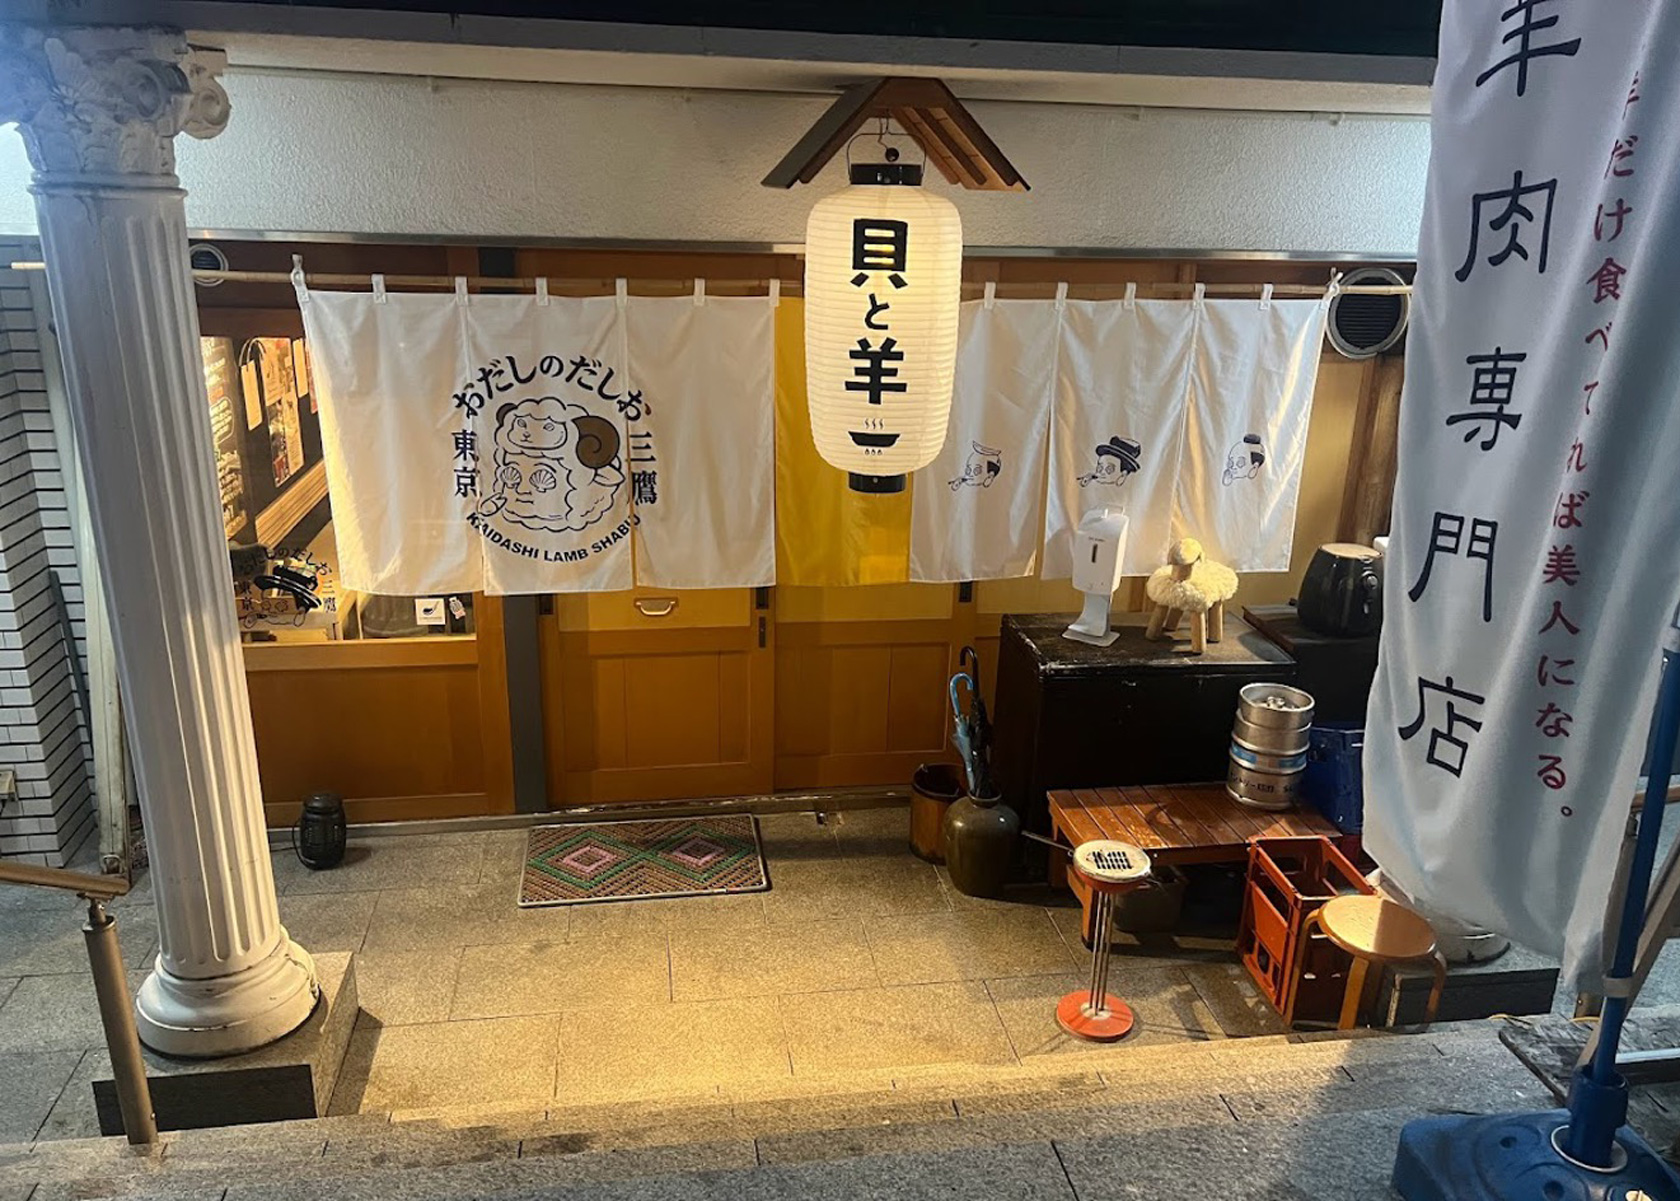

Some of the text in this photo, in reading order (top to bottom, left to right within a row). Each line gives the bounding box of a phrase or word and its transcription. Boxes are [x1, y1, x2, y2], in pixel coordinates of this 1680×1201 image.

[844, 218, 909, 405] 貝と羊
[452, 355, 652, 422] おだしのだしお
[1397, 0, 1582, 778] 羊肉専門店
[451, 429, 481, 499] 東京
[627, 431, 658, 506] 三鷹
[466, 512, 539, 559] KAIDASHI
[543, 549, 589, 562] LAMB
